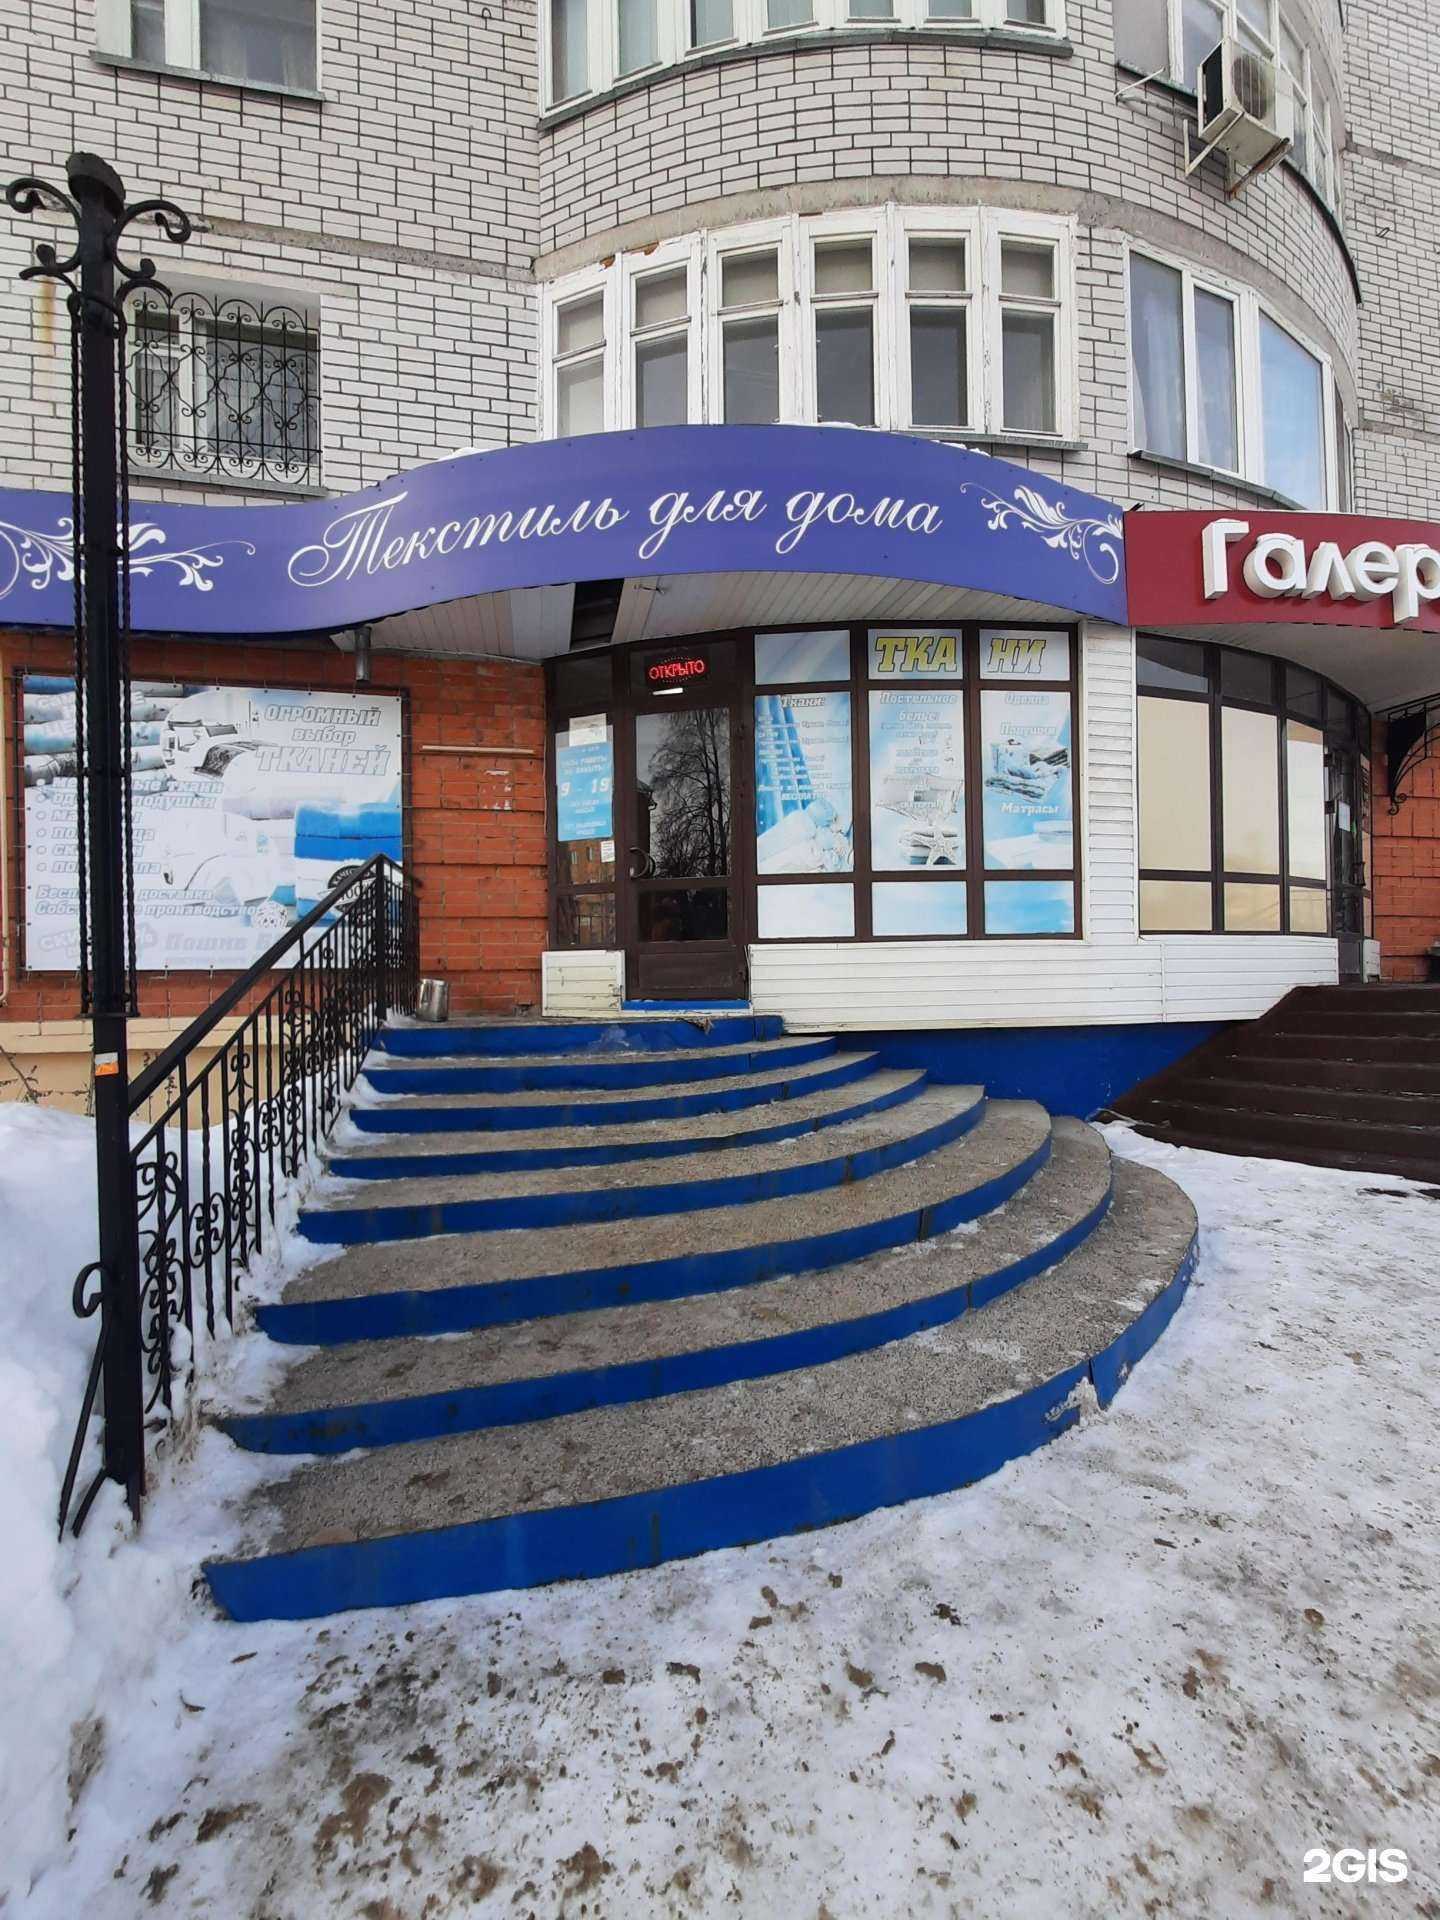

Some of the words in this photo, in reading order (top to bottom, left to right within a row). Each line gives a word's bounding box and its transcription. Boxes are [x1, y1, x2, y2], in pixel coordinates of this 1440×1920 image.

[287, 490, 629, 588] Текстиль
[637, 487, 767, 560] для
[775, 487, 943, 555] дома
[874, 635, 957, 673] ТКА
[988, 638, 1047, 674] НИ
[649, 659, 705, 681] ОТКРЫТО
[263, 703, 382, 727] ОГРОМНЫЙ
[291, 725, 357, 747] выбор
[255, 744, 391, 777] ТКАНЕЙ
